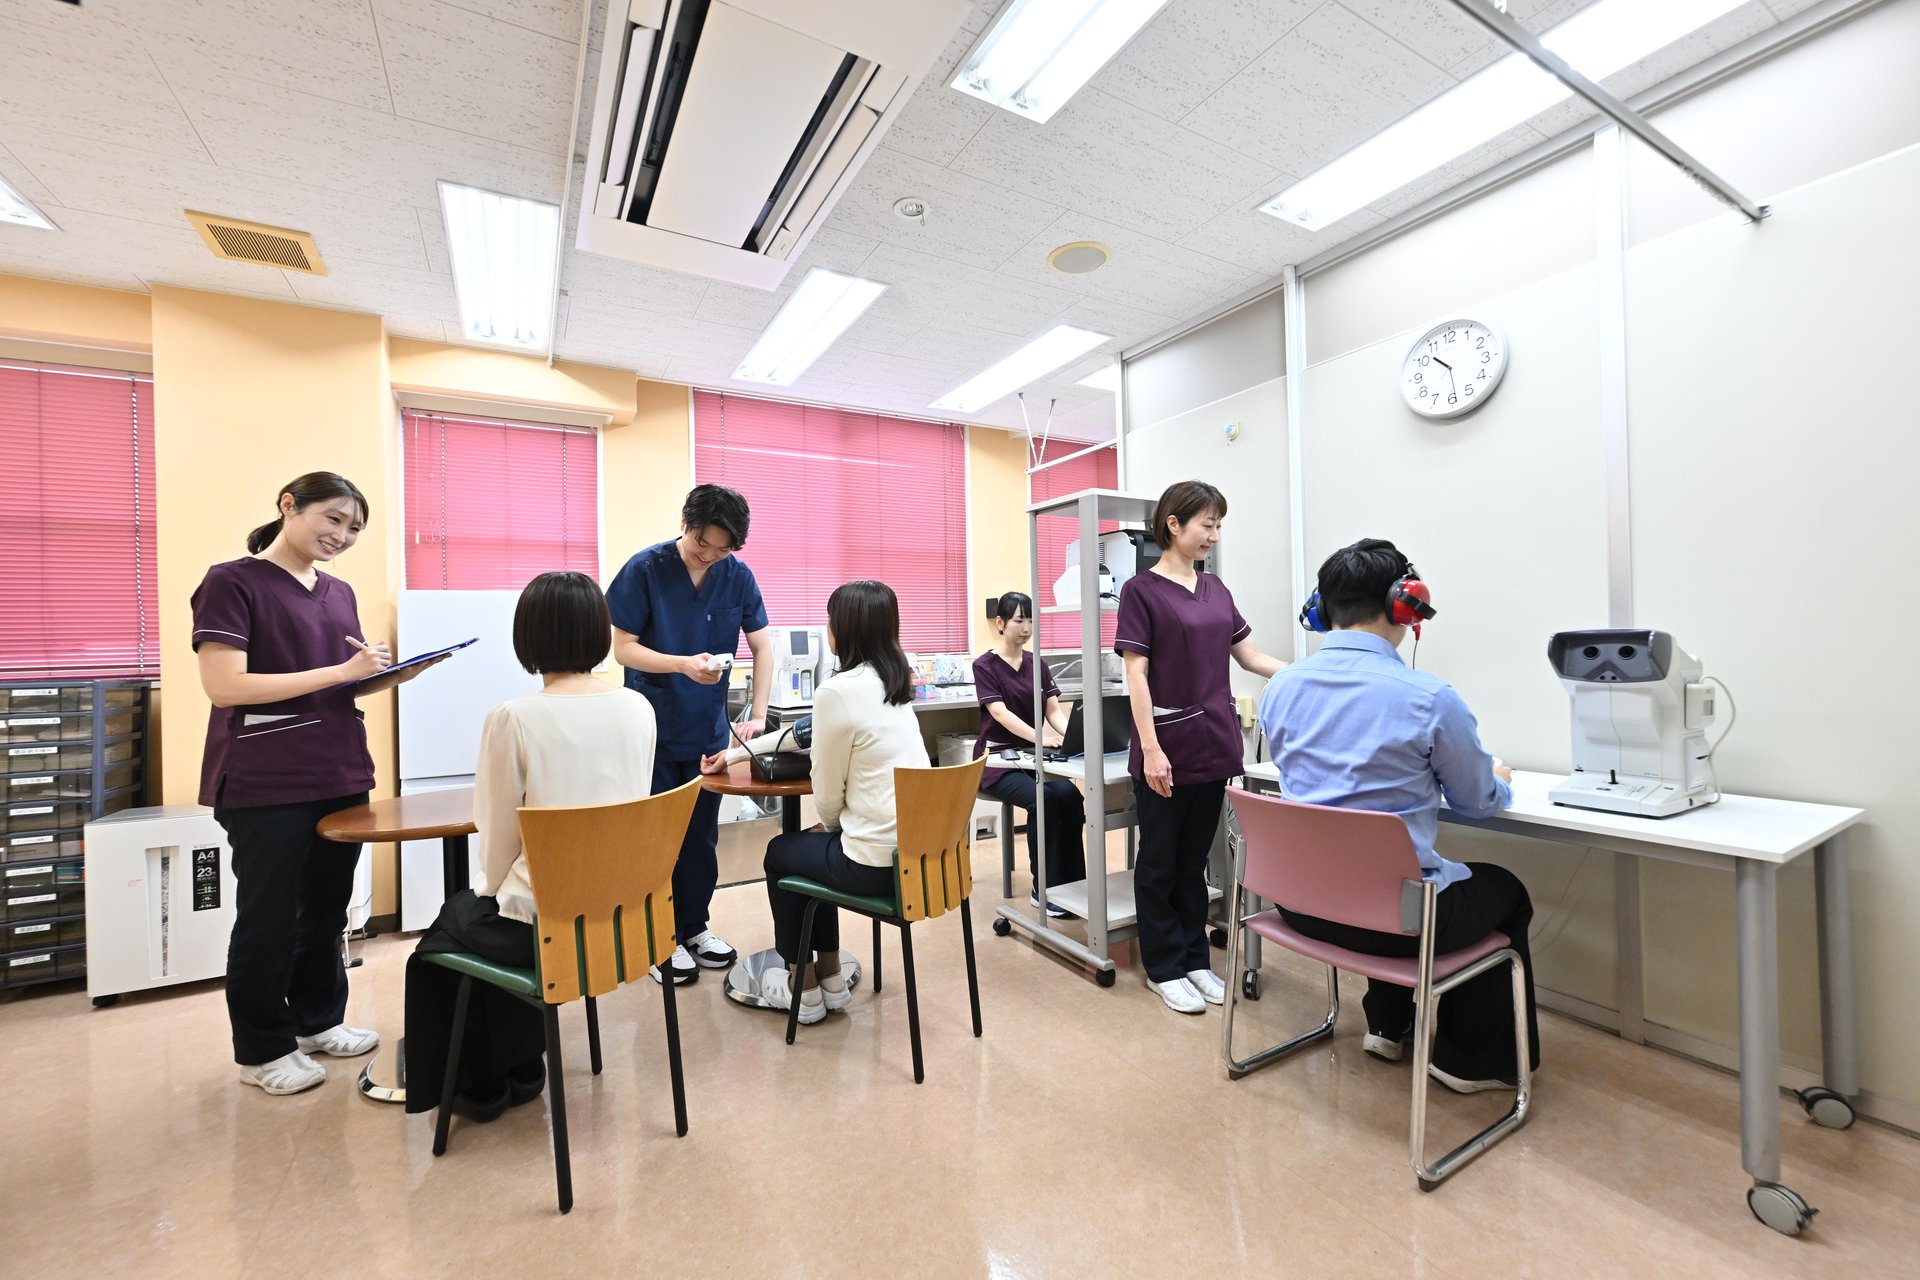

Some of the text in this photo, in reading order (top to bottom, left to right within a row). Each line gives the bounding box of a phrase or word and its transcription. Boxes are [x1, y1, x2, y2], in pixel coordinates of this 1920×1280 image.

[1442, 330, 1456, 344] 12
[1464, 330, 1470, 341] 1
[1428, 341, 1438, 353] 11
[1476, 337, 1485, 350] 2
[1417, 355, 1430, 368] 10
[1481, 351, 1490, 364] 3
[1414, 373, 1423, 384] 9
[1476, 368, 1486, 380] 4
[1419, 386, 1428, 398] 8
[1464, 384, 1474, 396] 5
[1431, 393, 1440, 405] 7
[1447, 392, 1457, 405] 6
[197, 850, 215, 860] A4
